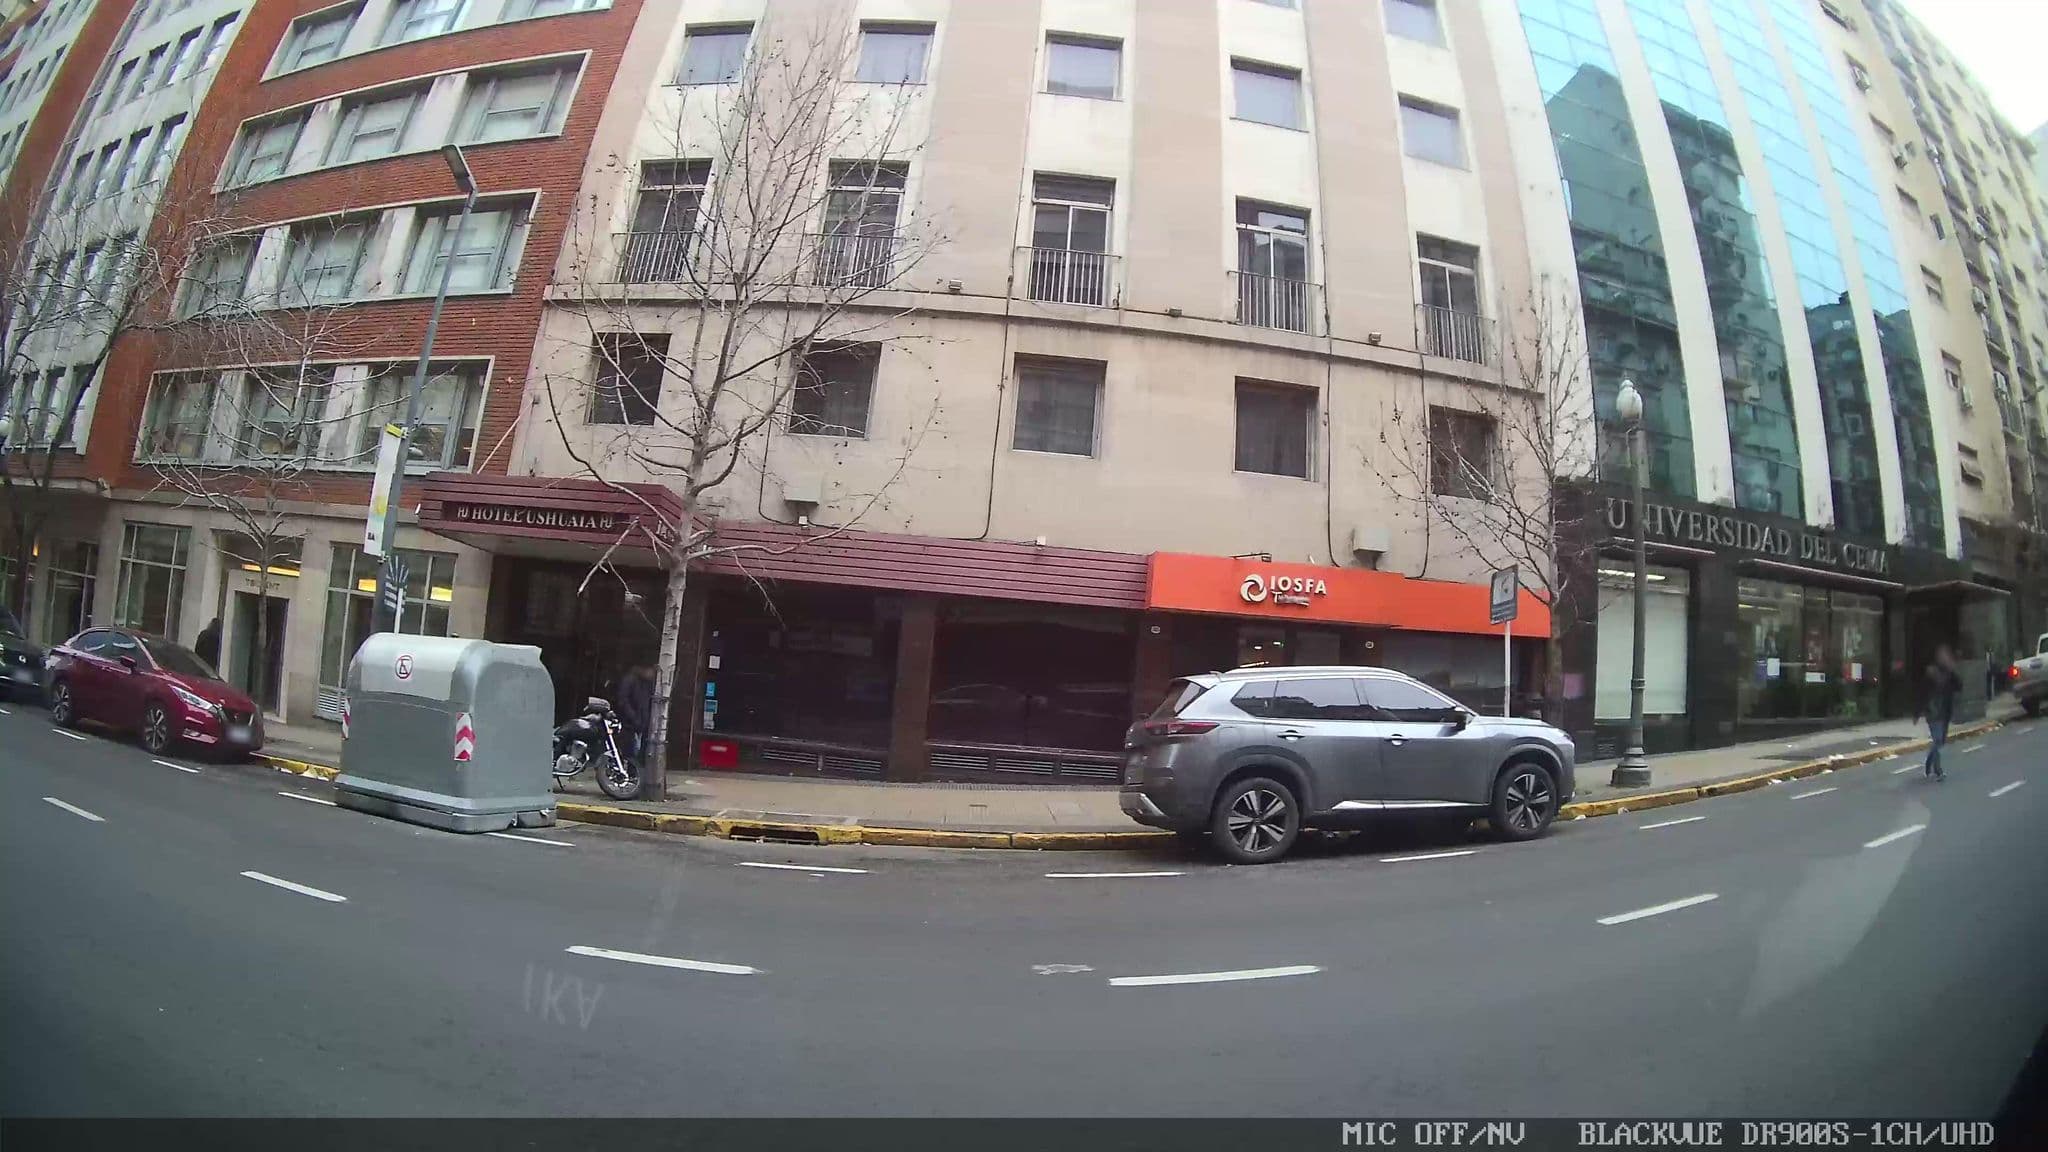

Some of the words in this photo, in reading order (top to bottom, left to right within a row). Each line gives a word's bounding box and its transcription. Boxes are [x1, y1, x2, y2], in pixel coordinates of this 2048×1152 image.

[472, 506, 523, 523] HOTEL
[526, 509, 597, 529] USHUAIA
[1800, 533, 1838, 565] DEL
[1270, 575, 1328, 596] IOSFA
